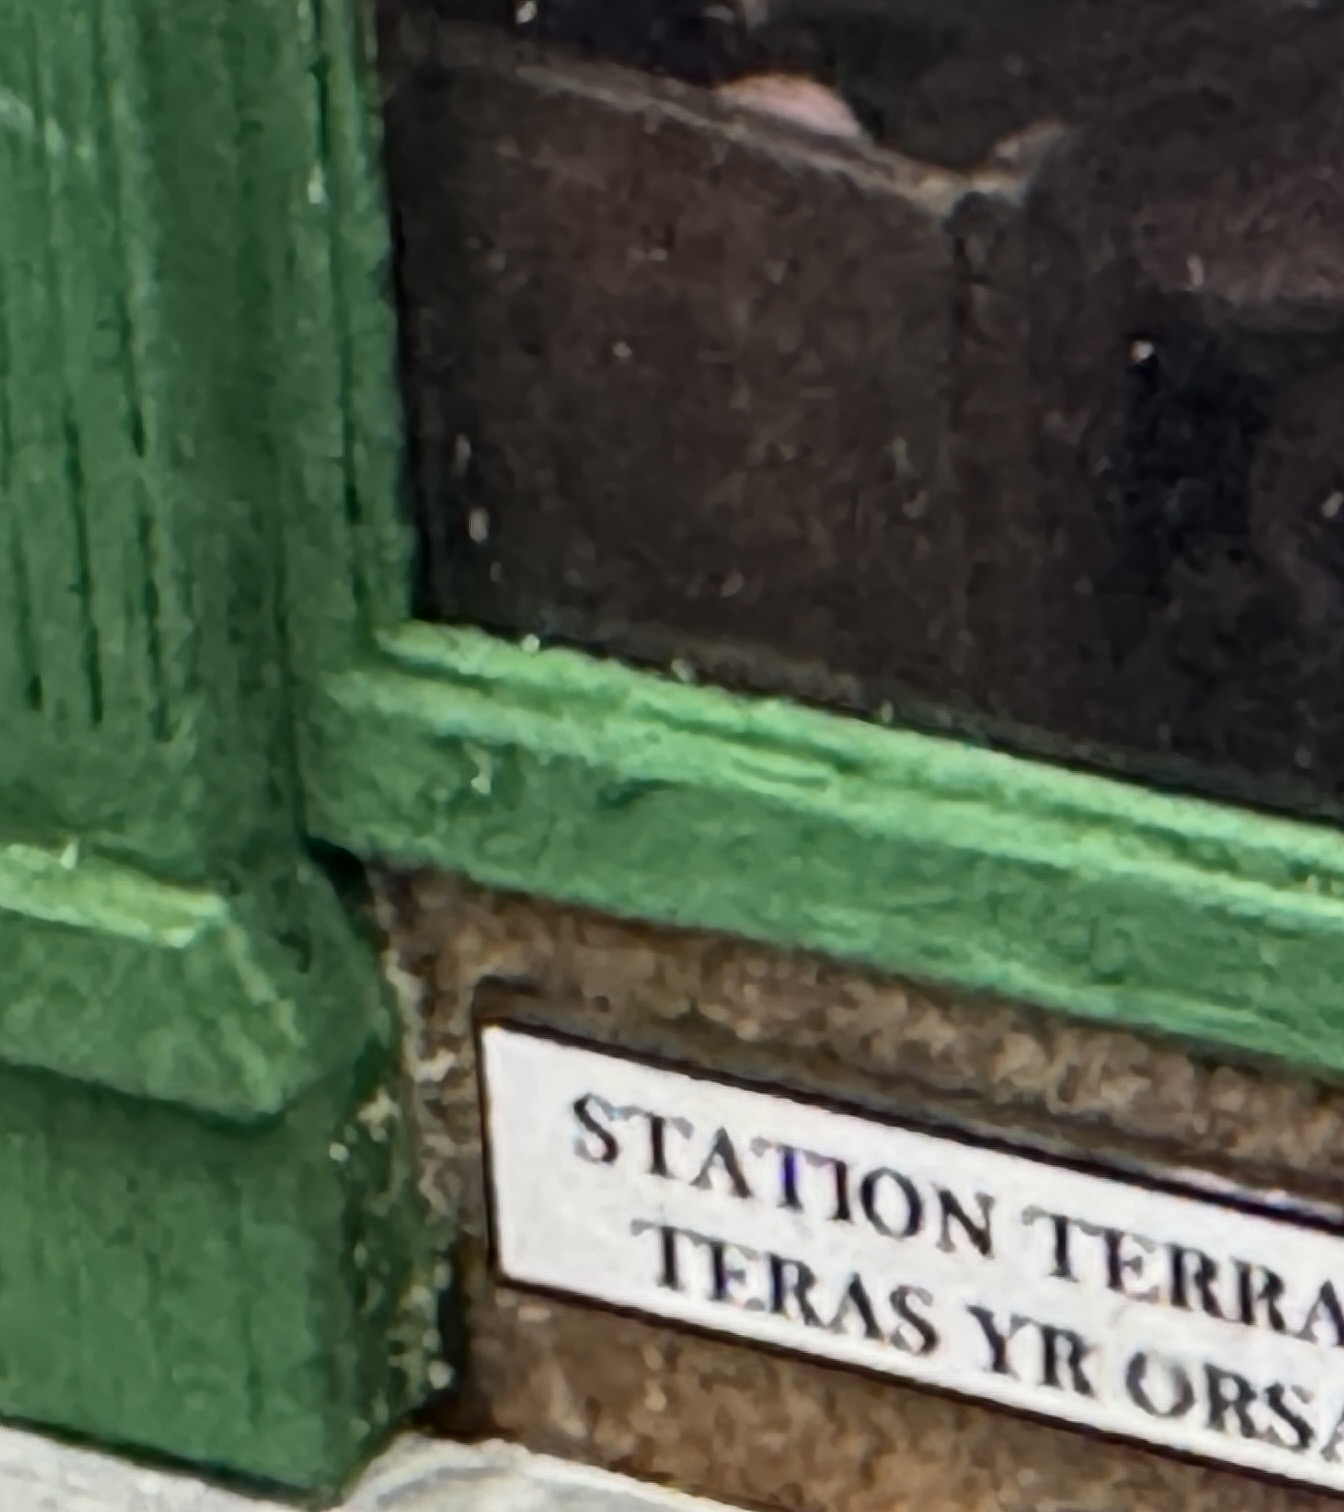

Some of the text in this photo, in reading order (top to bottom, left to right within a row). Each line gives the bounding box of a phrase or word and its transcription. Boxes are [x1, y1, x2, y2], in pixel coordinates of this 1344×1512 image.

[572, 1094, 995, 1257] STATION
[631, 1217, 940, 1355] TERAS
[966, 1303, 1096, 1397] YR
